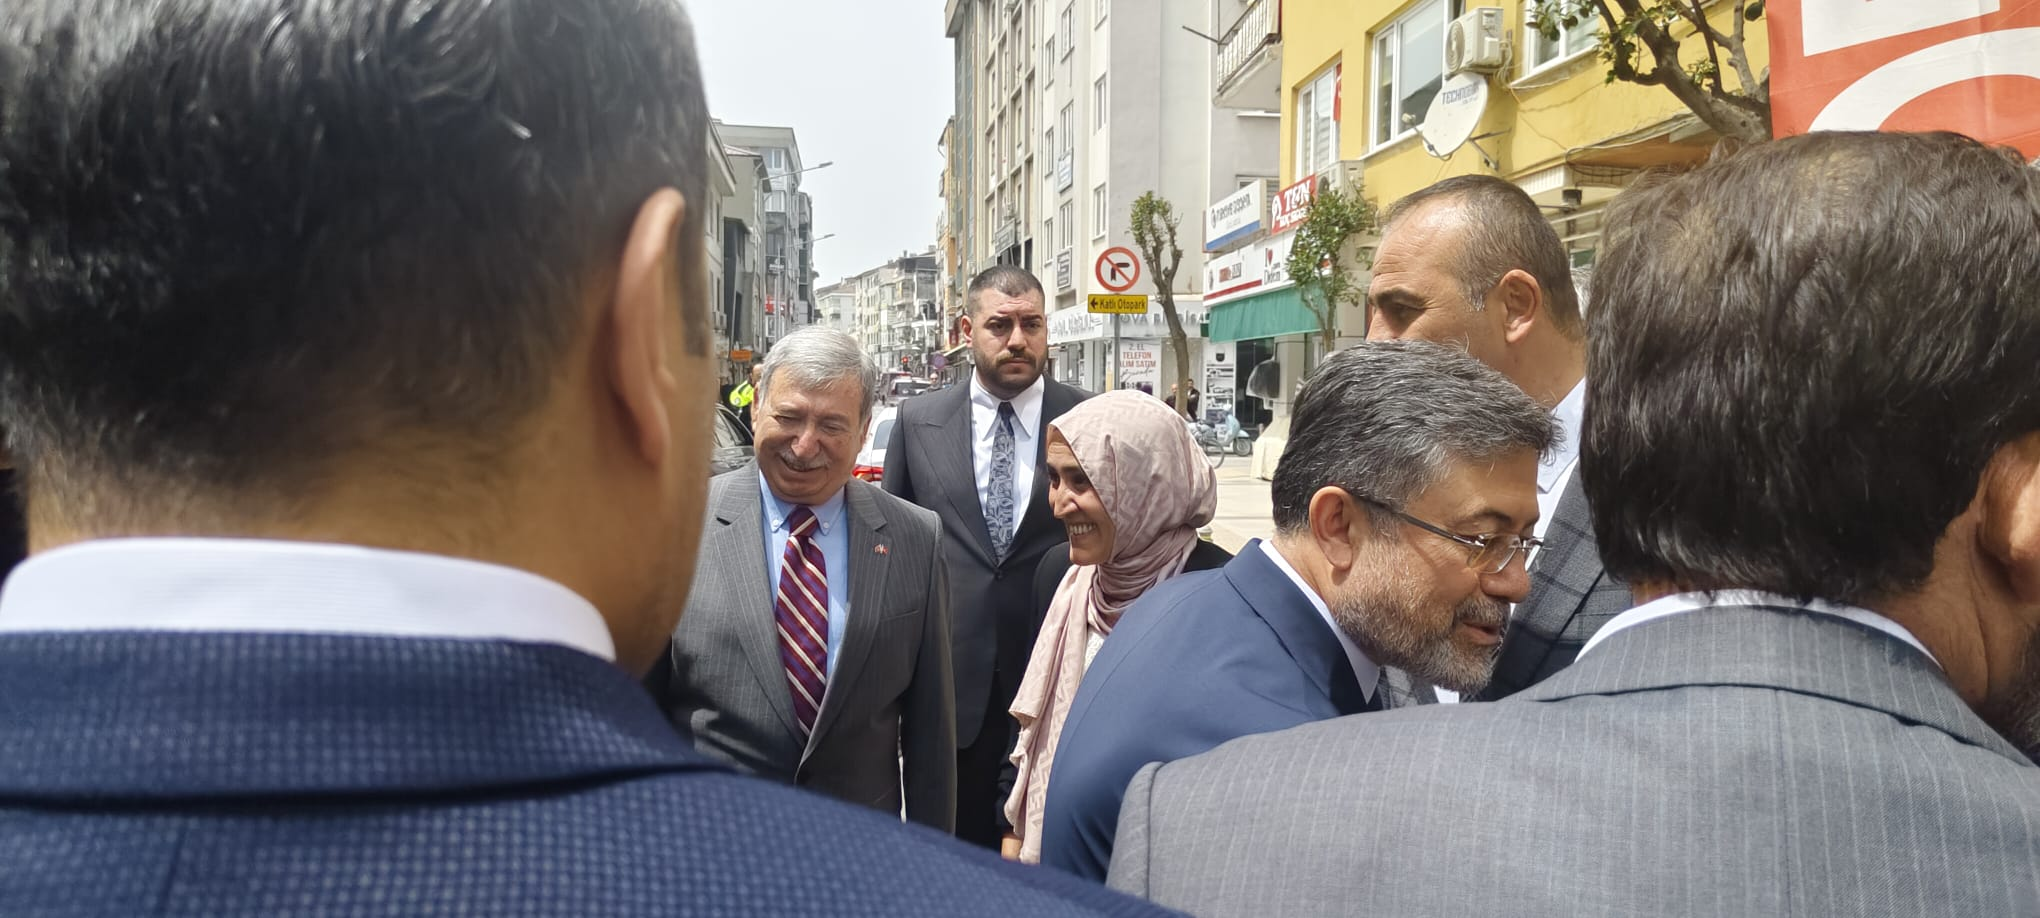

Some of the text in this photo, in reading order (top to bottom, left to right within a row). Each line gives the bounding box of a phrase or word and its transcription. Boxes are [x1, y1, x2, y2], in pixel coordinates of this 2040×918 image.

[1100, 299, 1146, 313] Katlı Otopark
[1123, 351, 1152, 360] TELEFON
[1136, 360, 1156, 368] SATIM
